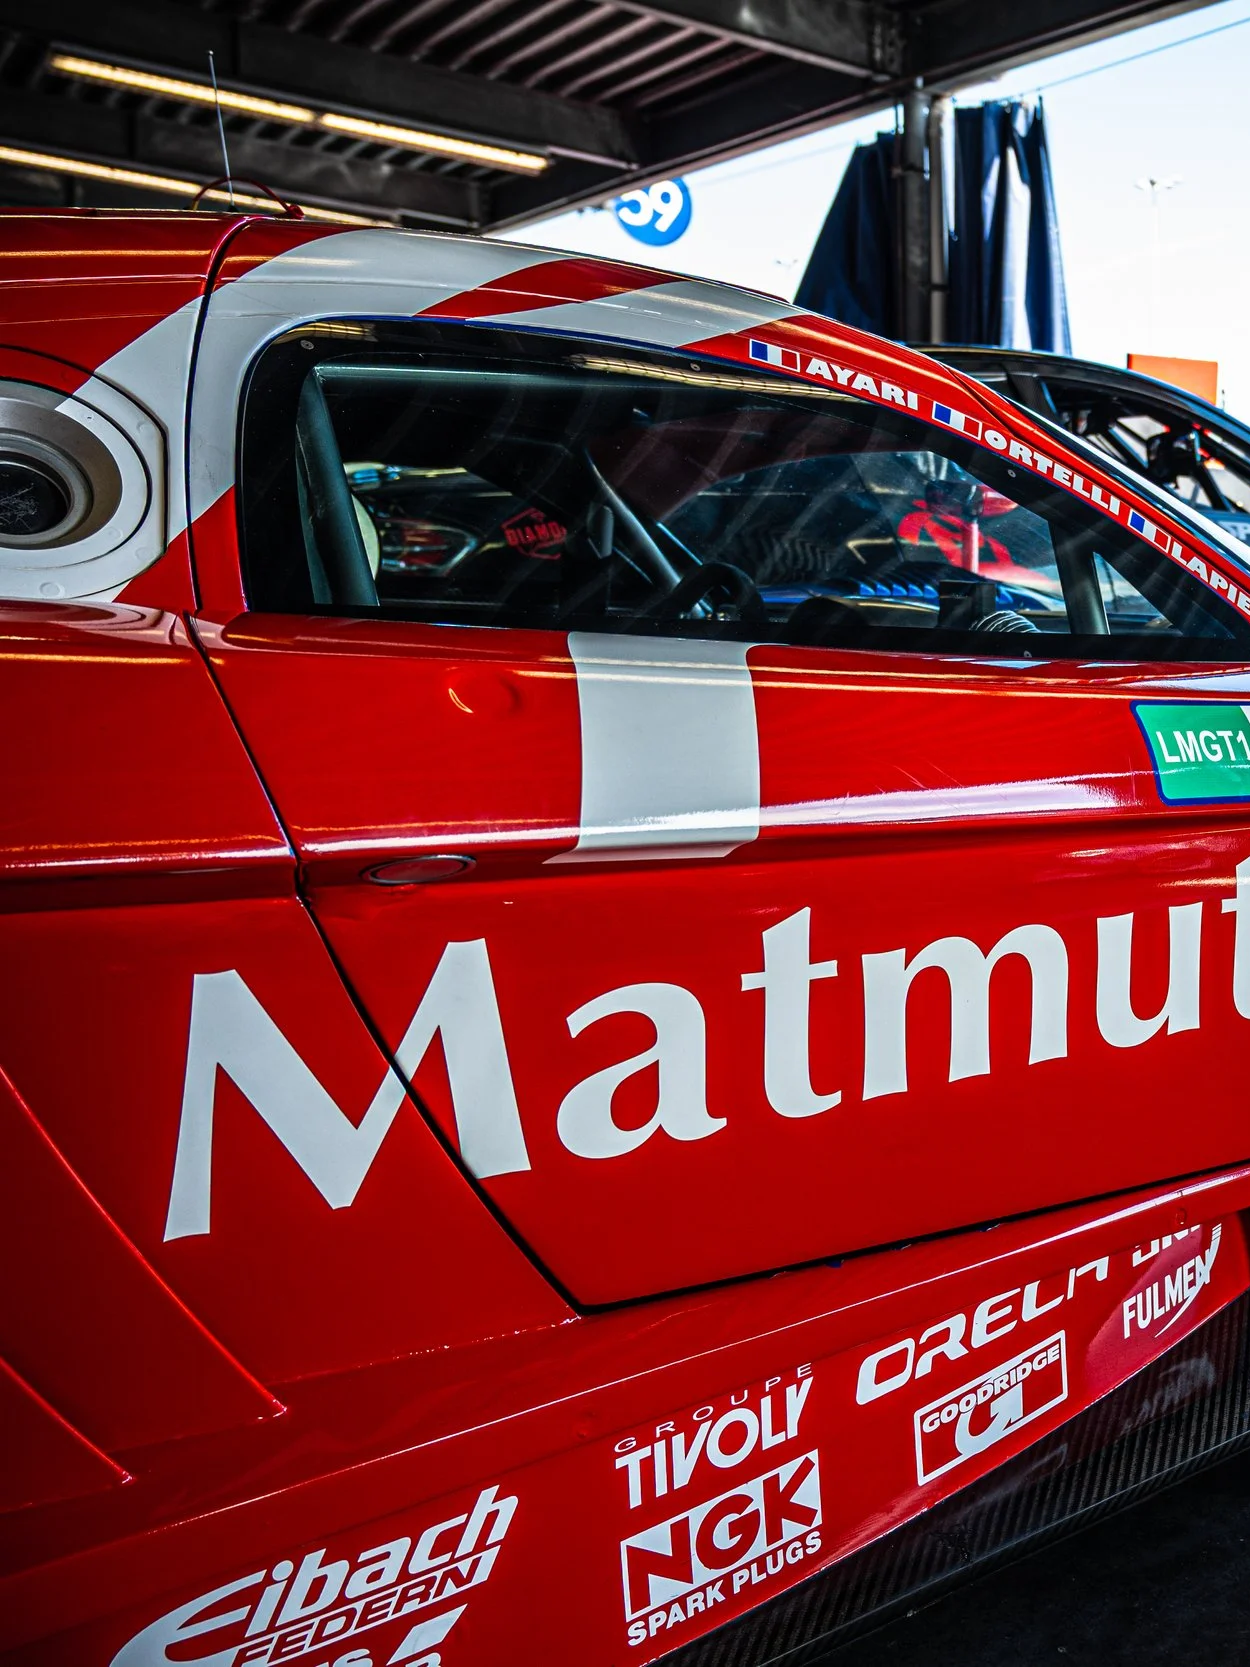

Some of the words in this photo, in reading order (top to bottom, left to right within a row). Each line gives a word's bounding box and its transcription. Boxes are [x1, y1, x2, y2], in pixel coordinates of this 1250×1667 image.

[806, 357, 919, 410] AYARI
[984, 429, 1121, 516] ORTELLI
[1122, 1248, 1211, 1340] FULMEN
[613, 1362, 812, 1453] GROUPE
[921, 1344, 1061, 1434] GOODRIDGE
[615, 1376, 814, 1510] TIVOLY
[108, 1484, 519, 1667] Eibach
[622, 1452, 820, 1620] NGK
[232, 1555, 490, 1667] FEDERN
[627, 1580, 727, 1647] SPARK
[732, 1530, 822, 1594] PLUGS
